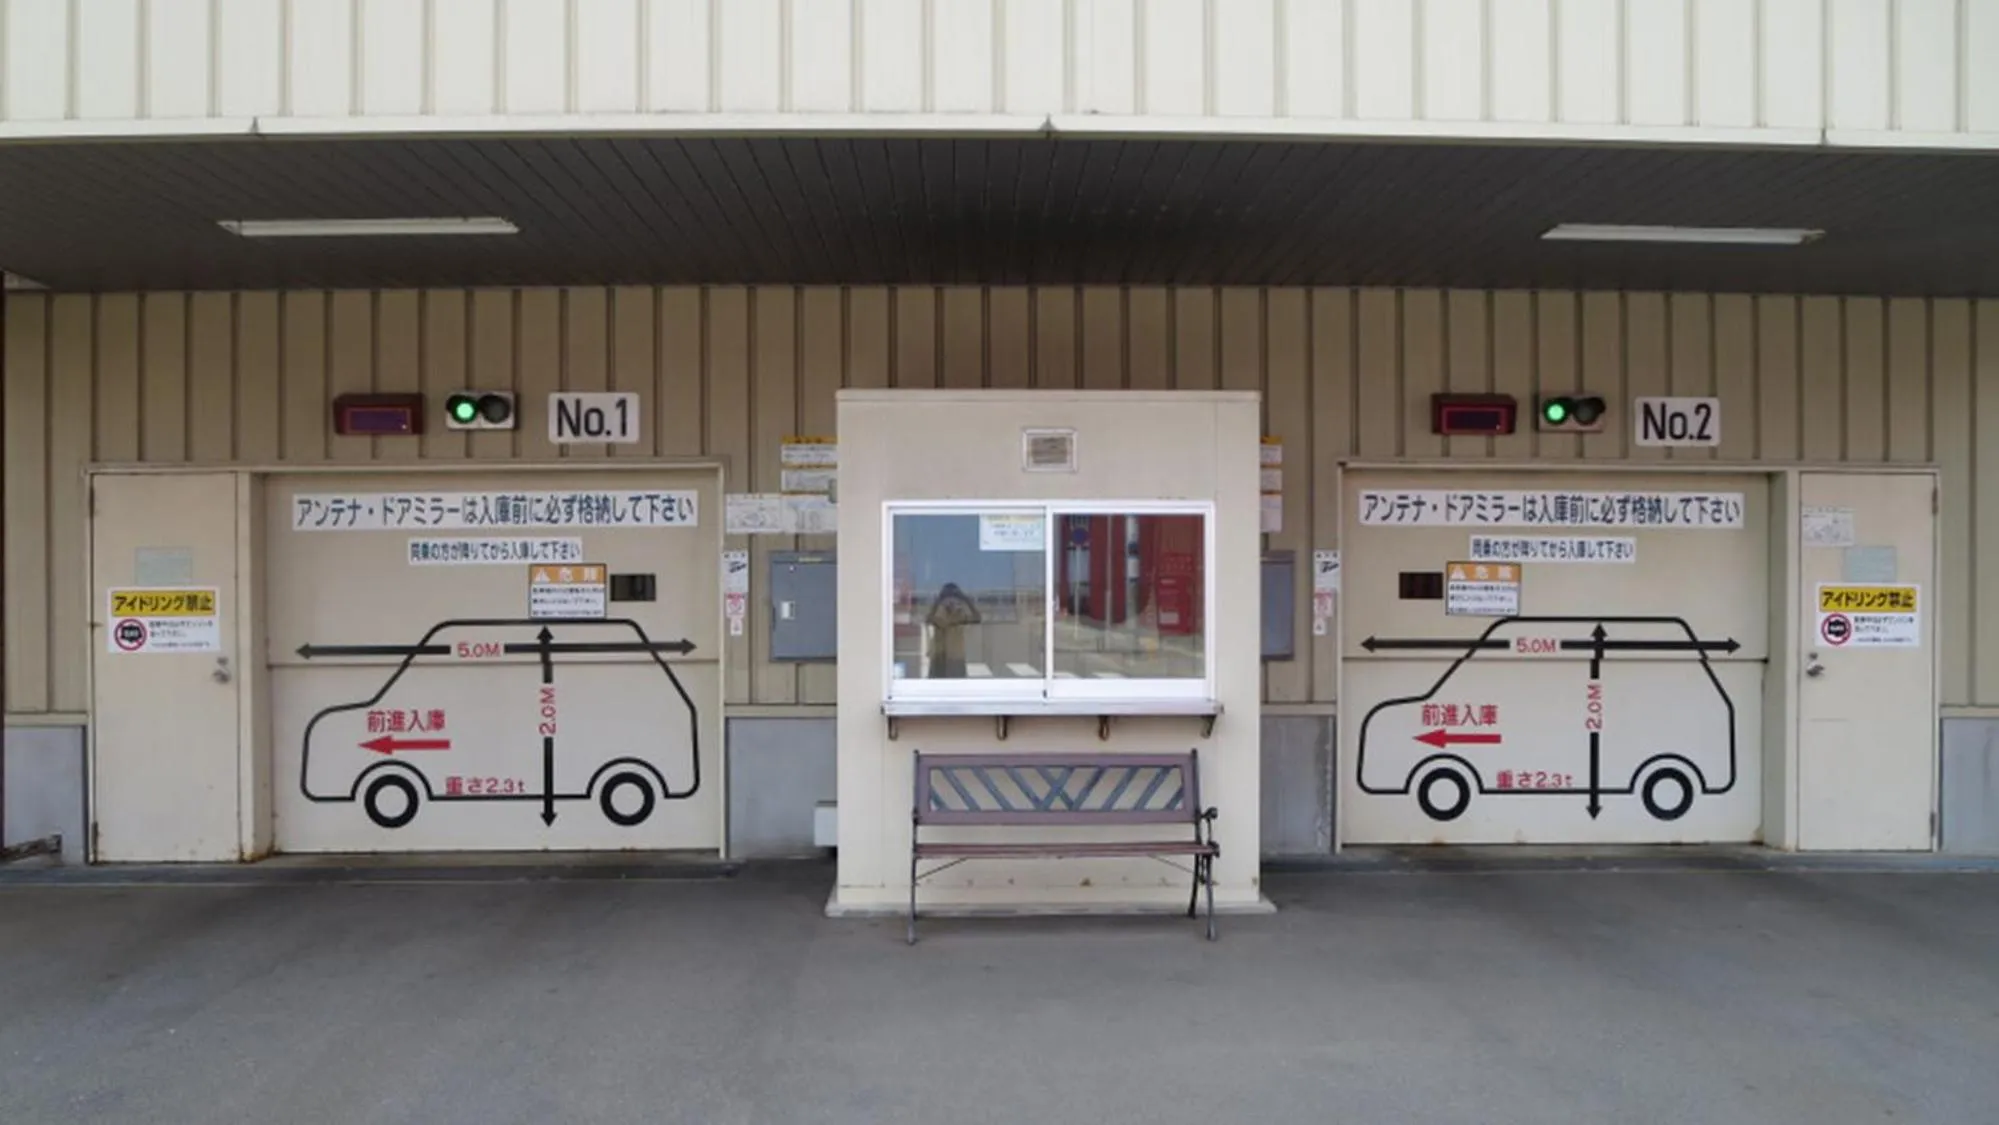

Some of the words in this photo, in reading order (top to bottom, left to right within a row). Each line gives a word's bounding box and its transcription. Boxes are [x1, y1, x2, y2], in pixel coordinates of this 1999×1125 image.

[557, 398, 628, 437] No.1
[1643, 402, 1712, 440] No.2
[296, 495, 693, 527] アンテナ・ドアミラーは入庫前に必ず格納して下さい
[1363, 494, 1740, 525] アンテナ・ドアミラーは入庫前に必ず格納して下さい
[114, 594, 213, 612] アイドリング禁止
[1822, 591, 1914, 608] アイドリング禁止
[457, 643, 500, 658] 5.0M
[1516, 638, 1556, 653] 5.0M
[539, 687, 556, 735] 2.0M
[1422, 704, 1498, 726] 前進入庫
[1586, 684, 1602, 730] 2.0M
[367, 710, 445, 732] 前進入庫
